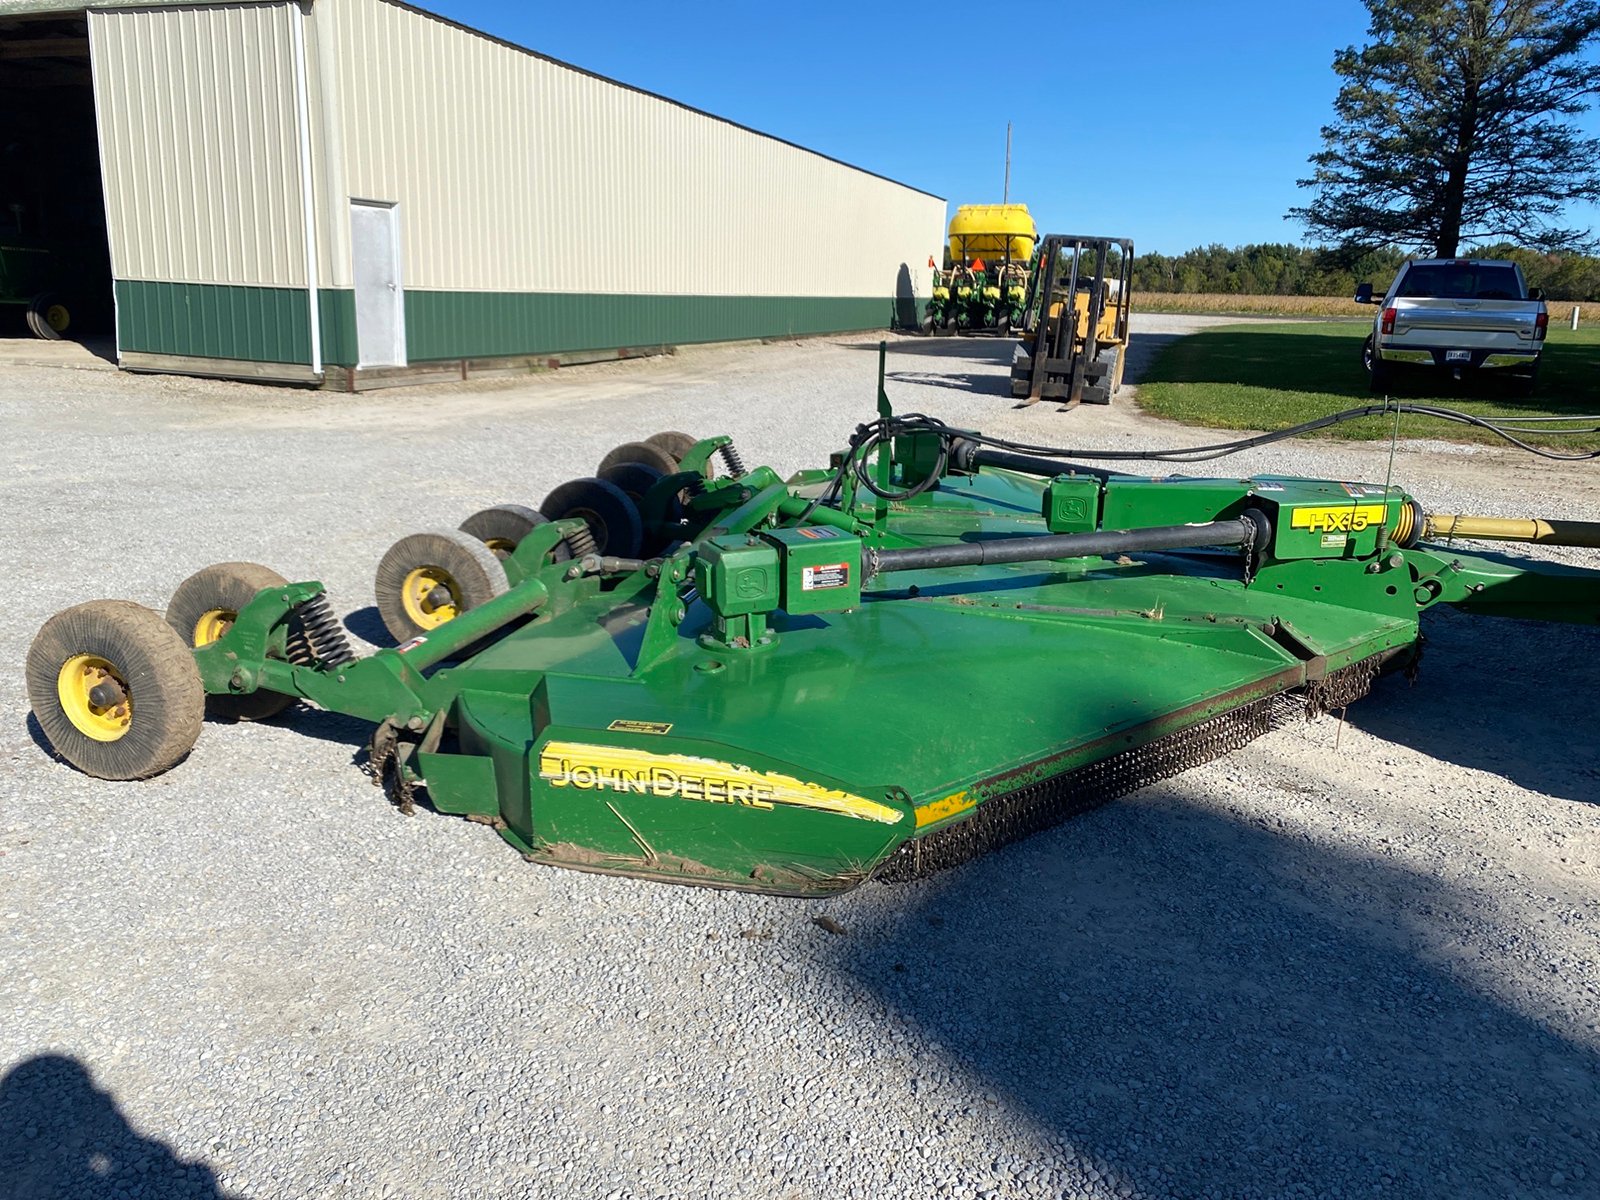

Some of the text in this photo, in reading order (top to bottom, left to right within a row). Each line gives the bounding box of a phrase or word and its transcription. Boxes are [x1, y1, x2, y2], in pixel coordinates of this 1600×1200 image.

[1309, 512, 1368, 533] HX15
[551, 758, 774, 811] JOHN DEERE
